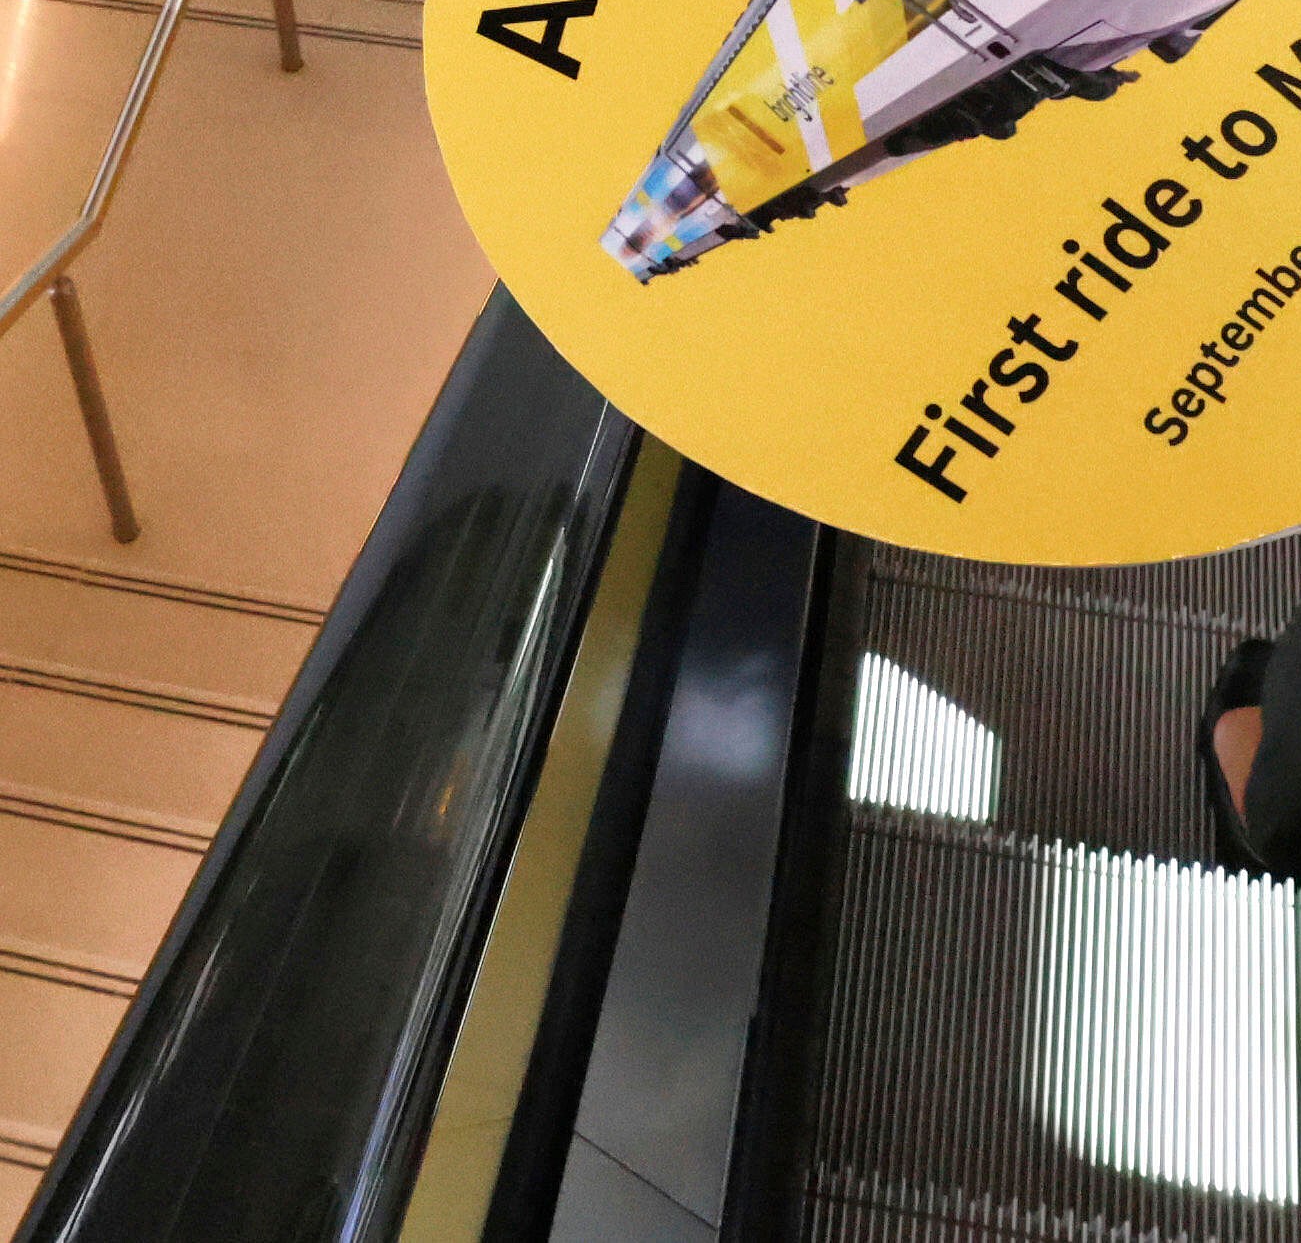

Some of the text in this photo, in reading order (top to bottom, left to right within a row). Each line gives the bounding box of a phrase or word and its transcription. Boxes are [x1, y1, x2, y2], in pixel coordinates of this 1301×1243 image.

[893, 313, 1080, 504] First
[1054, 177, 1204, 322] ride
[1180, 109, 1279, 180] to
